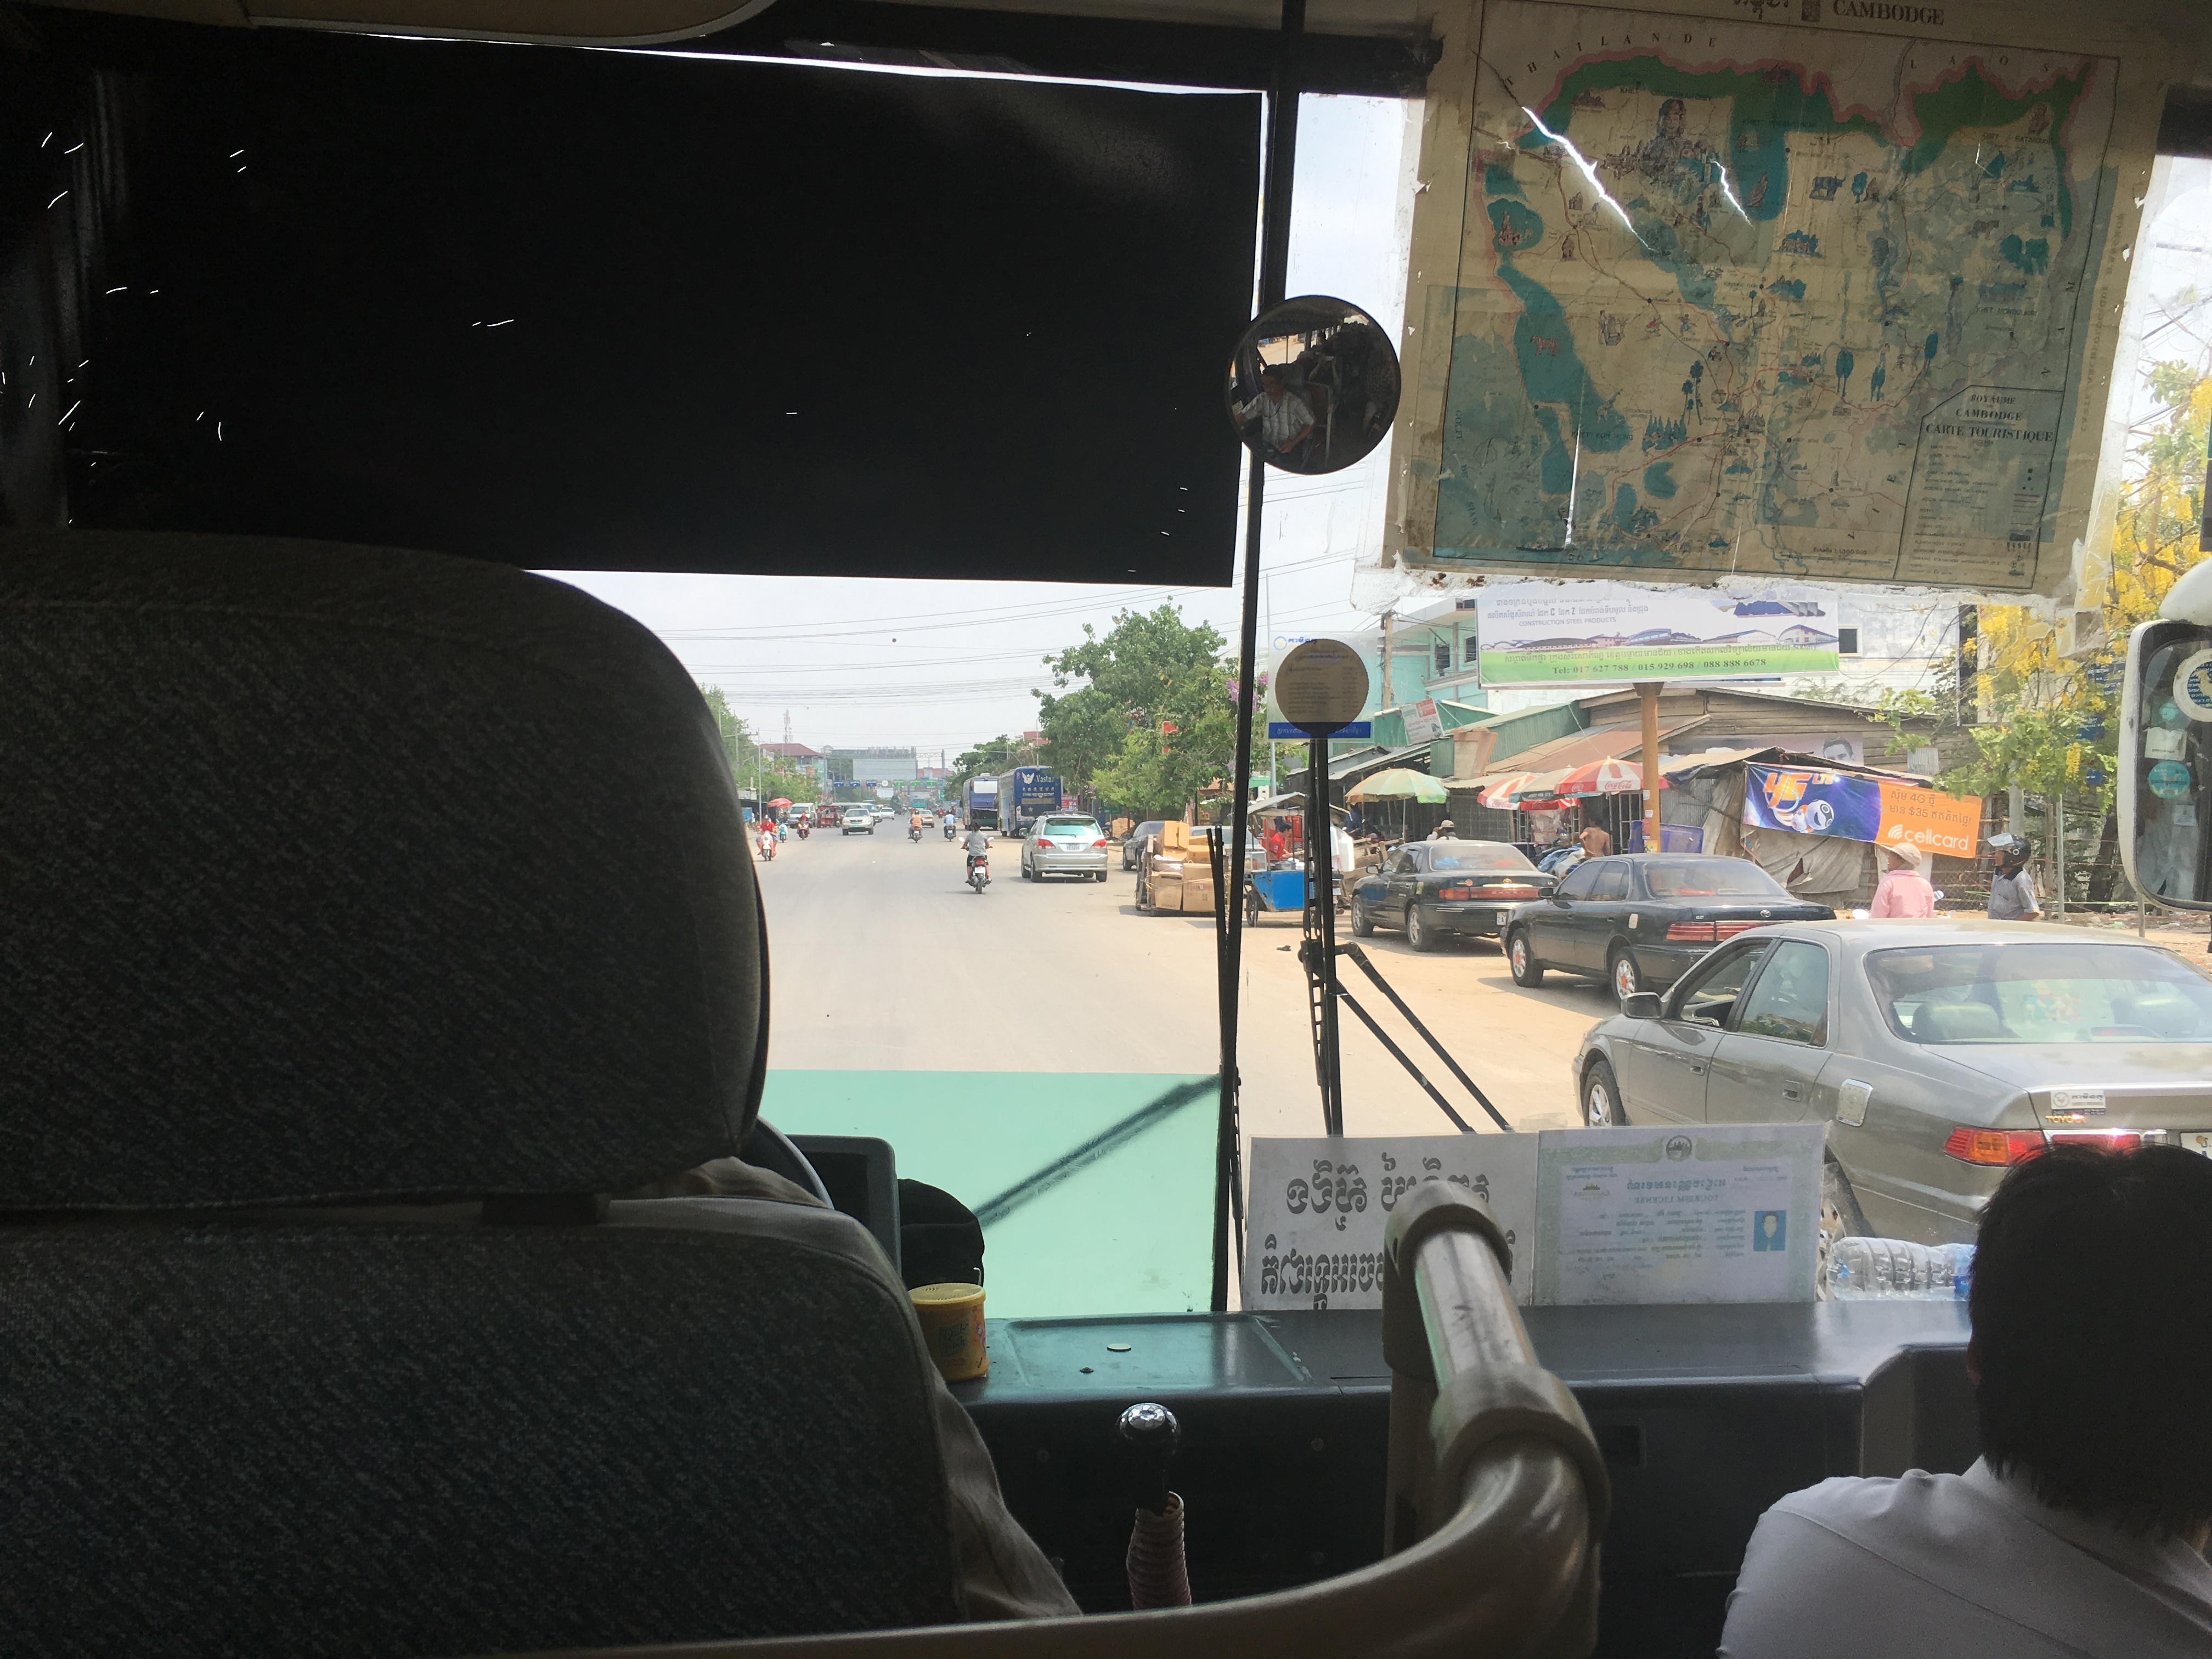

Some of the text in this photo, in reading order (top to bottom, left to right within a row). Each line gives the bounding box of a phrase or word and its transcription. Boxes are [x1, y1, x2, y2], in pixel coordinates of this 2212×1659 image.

[1833, 0, 1944, 25] CAMBODGE
[1504, 32, 1718, 87] THAILANDE
[1910, 55, 2051, 72] LAOS
[1971, 394, 2016, 404] ROYAUME
[1956, 409, 2023, 421] CAMBODGE
[1926, 424, 2053, 443] CARTE TOURISTIQUE
[1550, 608, 1555, 616] C
[1743, 658, 1767, 667] 6678
[1763, 772, 1833, 808] 4G LTE
[1910, 794, 1926, 804] 4G
[1909, 806, 1928, 818] $35
[1904, 828, 1969, 850] cellcard
[2045, 1115, 2086, 1124] TOYOA
